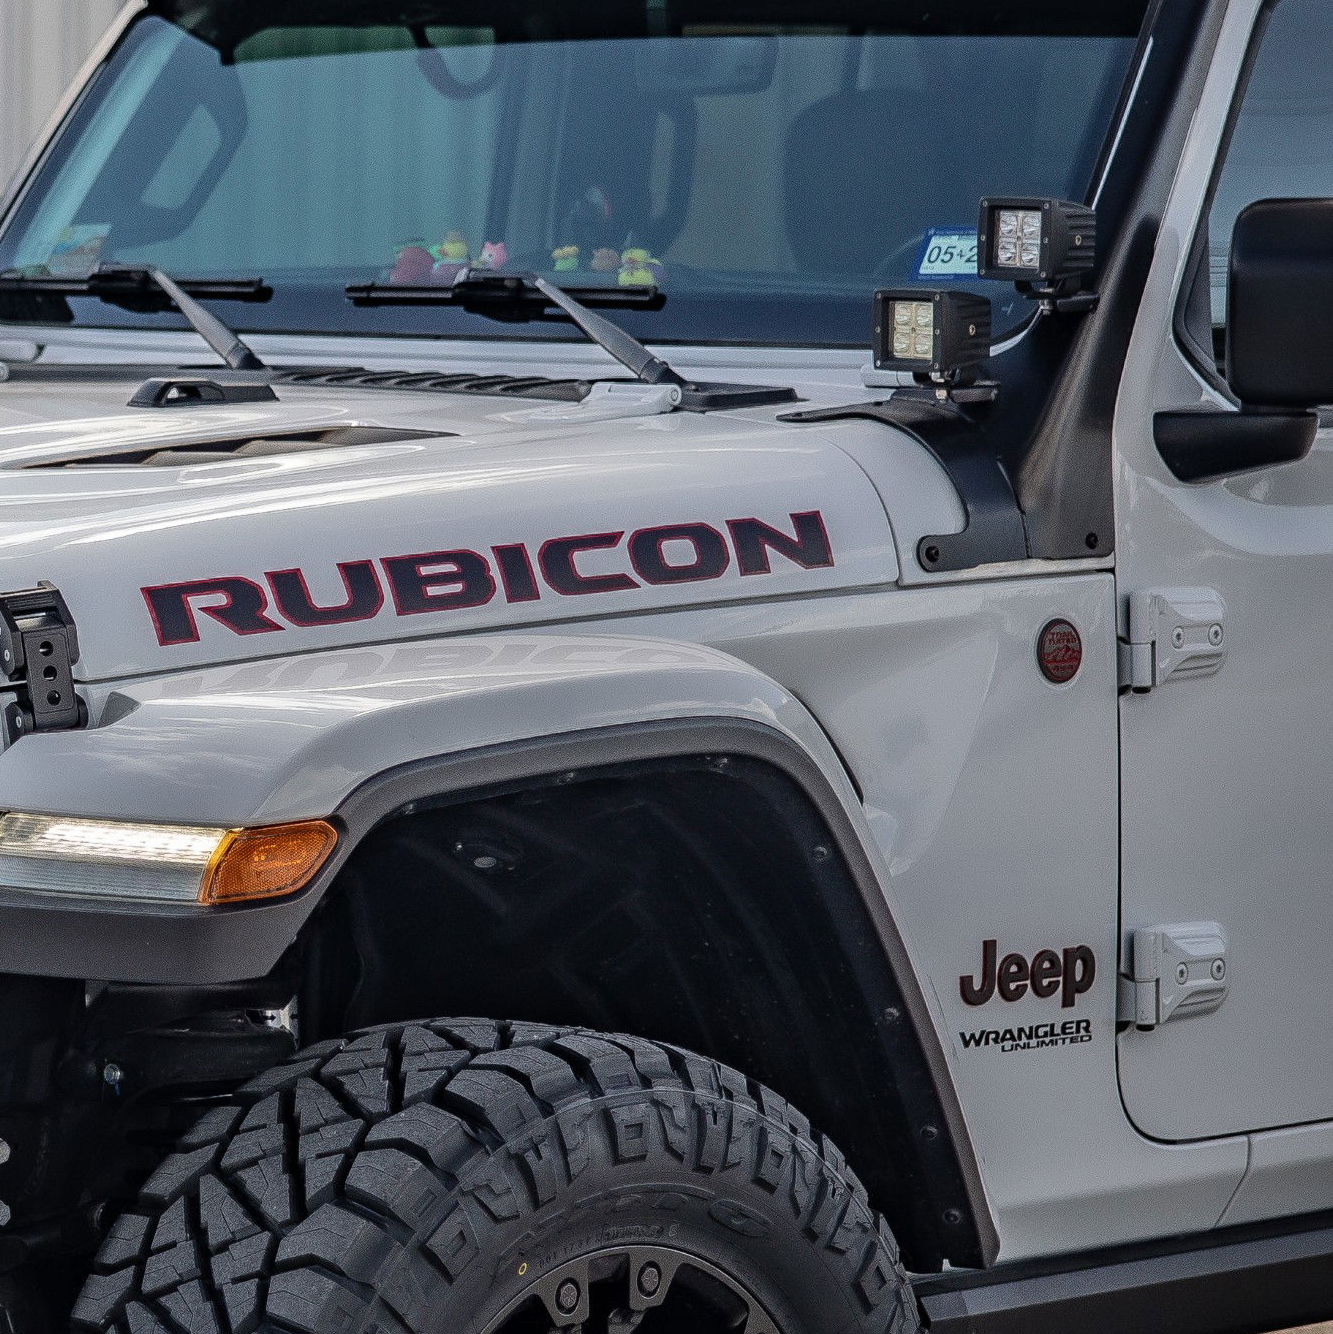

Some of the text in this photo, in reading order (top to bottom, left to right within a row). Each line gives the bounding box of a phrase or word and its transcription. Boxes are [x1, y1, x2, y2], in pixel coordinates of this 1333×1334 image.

[140, 511, 835, 646] RUBICON
[959, 939, 1096, 1008] Jeep
[959, 1019, 1091, 1048] WRANGLER
[1001, 1034, 1093, 1052] UNLIMITED
